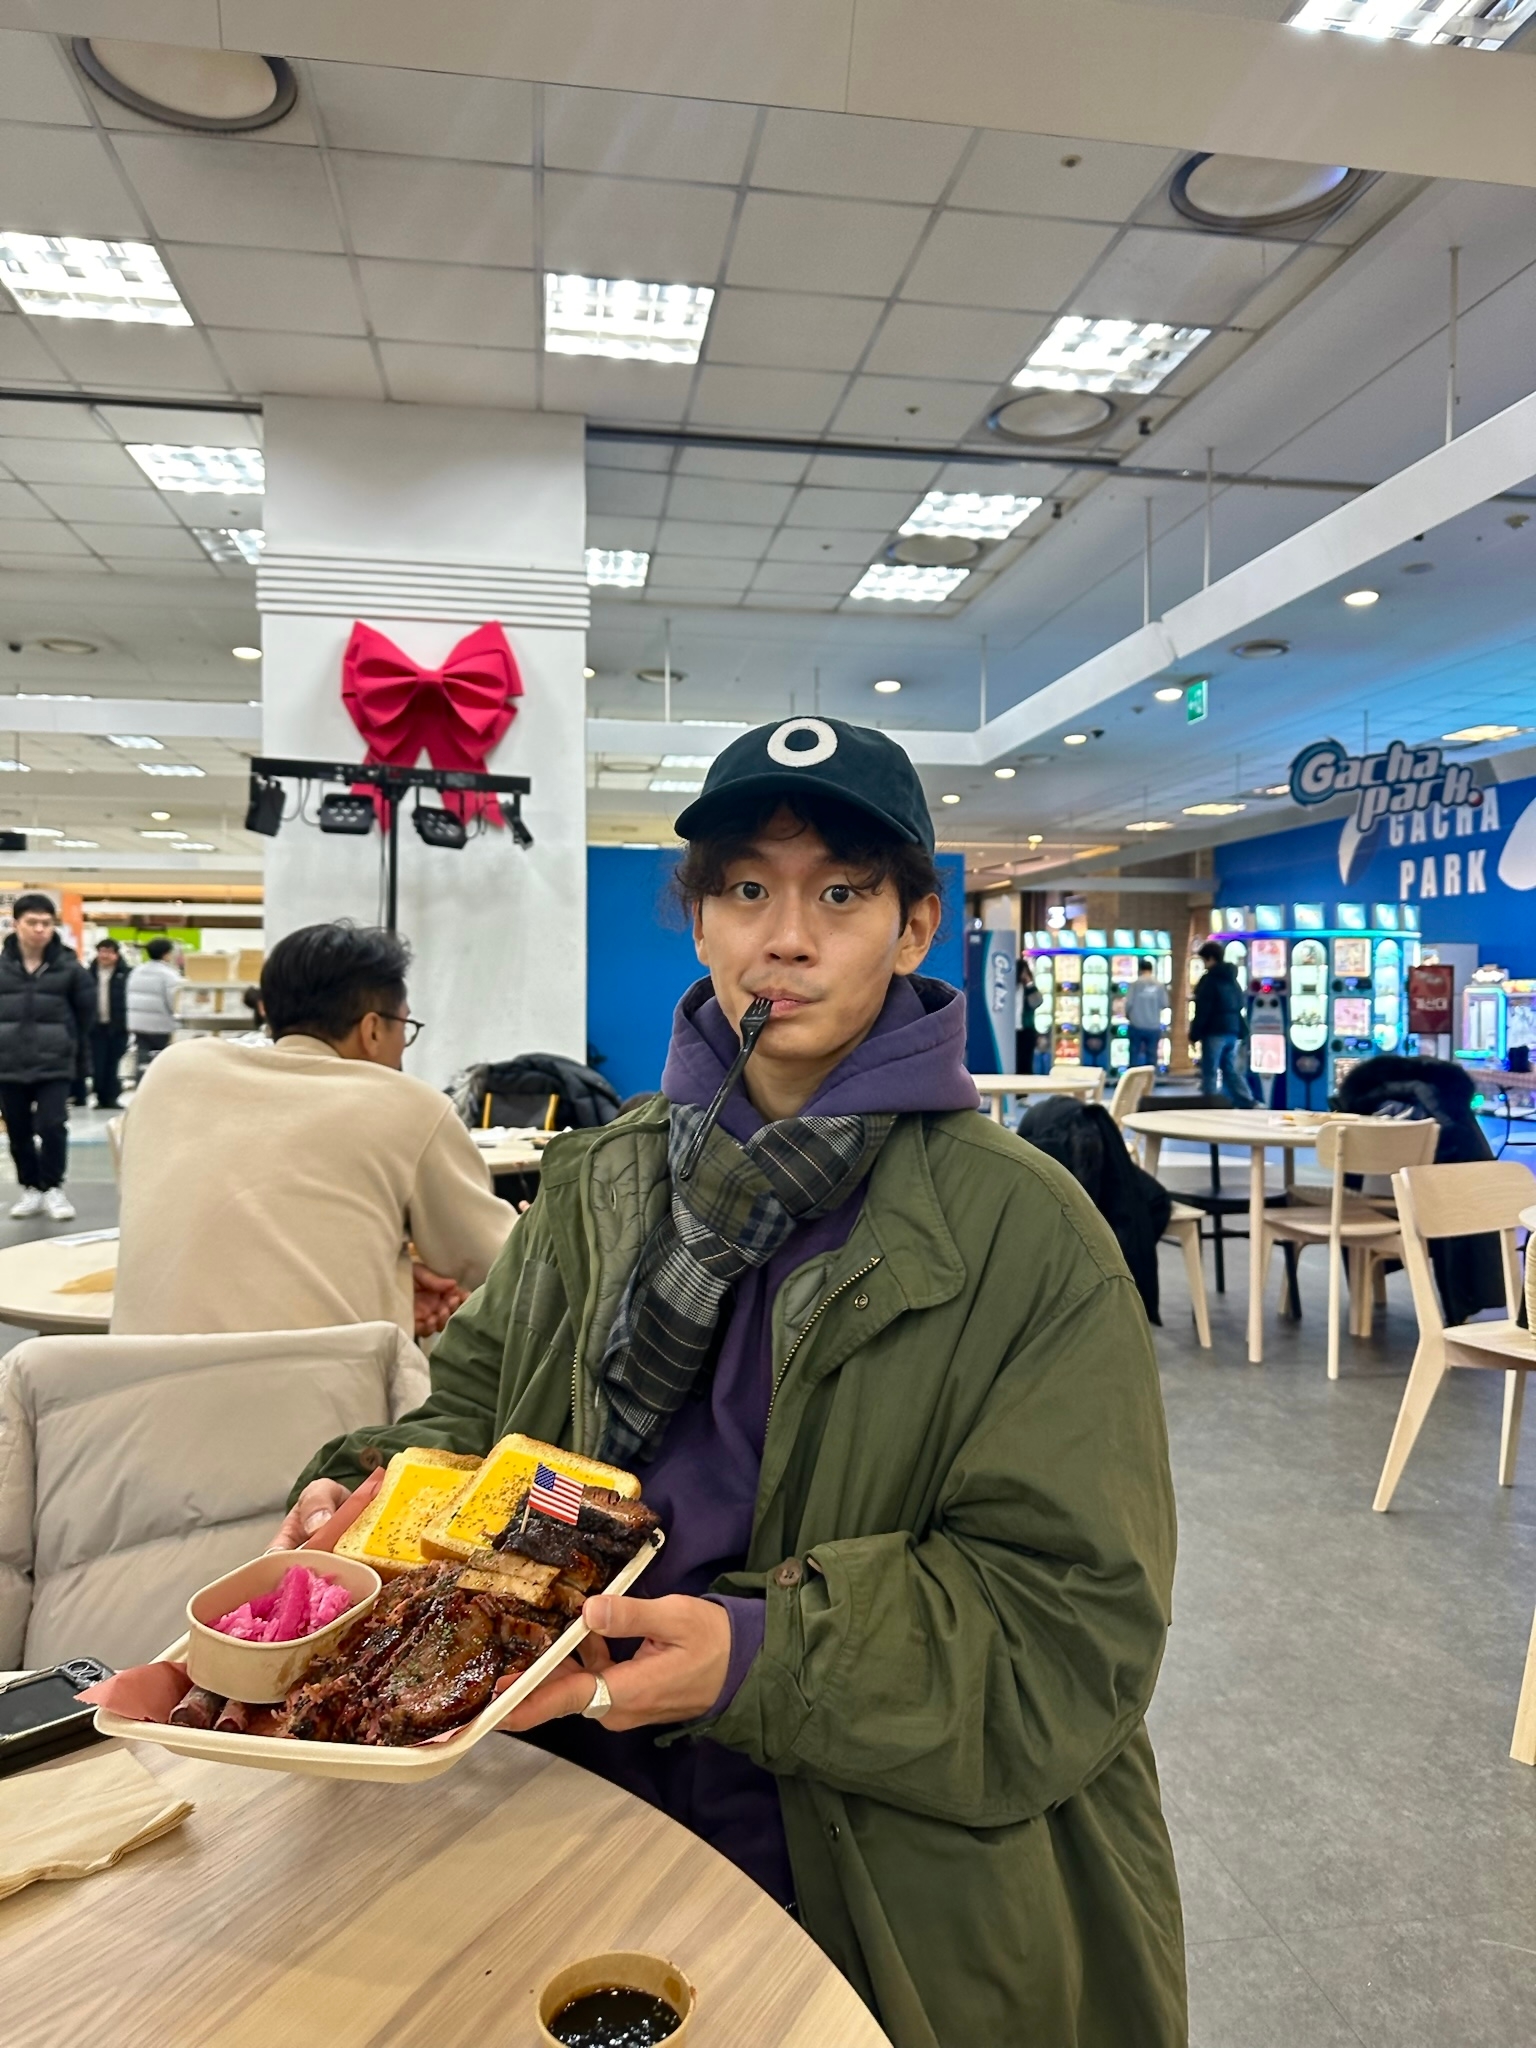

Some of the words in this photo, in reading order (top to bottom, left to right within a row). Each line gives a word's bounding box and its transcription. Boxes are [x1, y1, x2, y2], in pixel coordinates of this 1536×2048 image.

[1292, 741, 1441, 800] Gacha
[1389, 787, 1500, 847] GACHA
[1400, 849, 1487, 900] PARK
